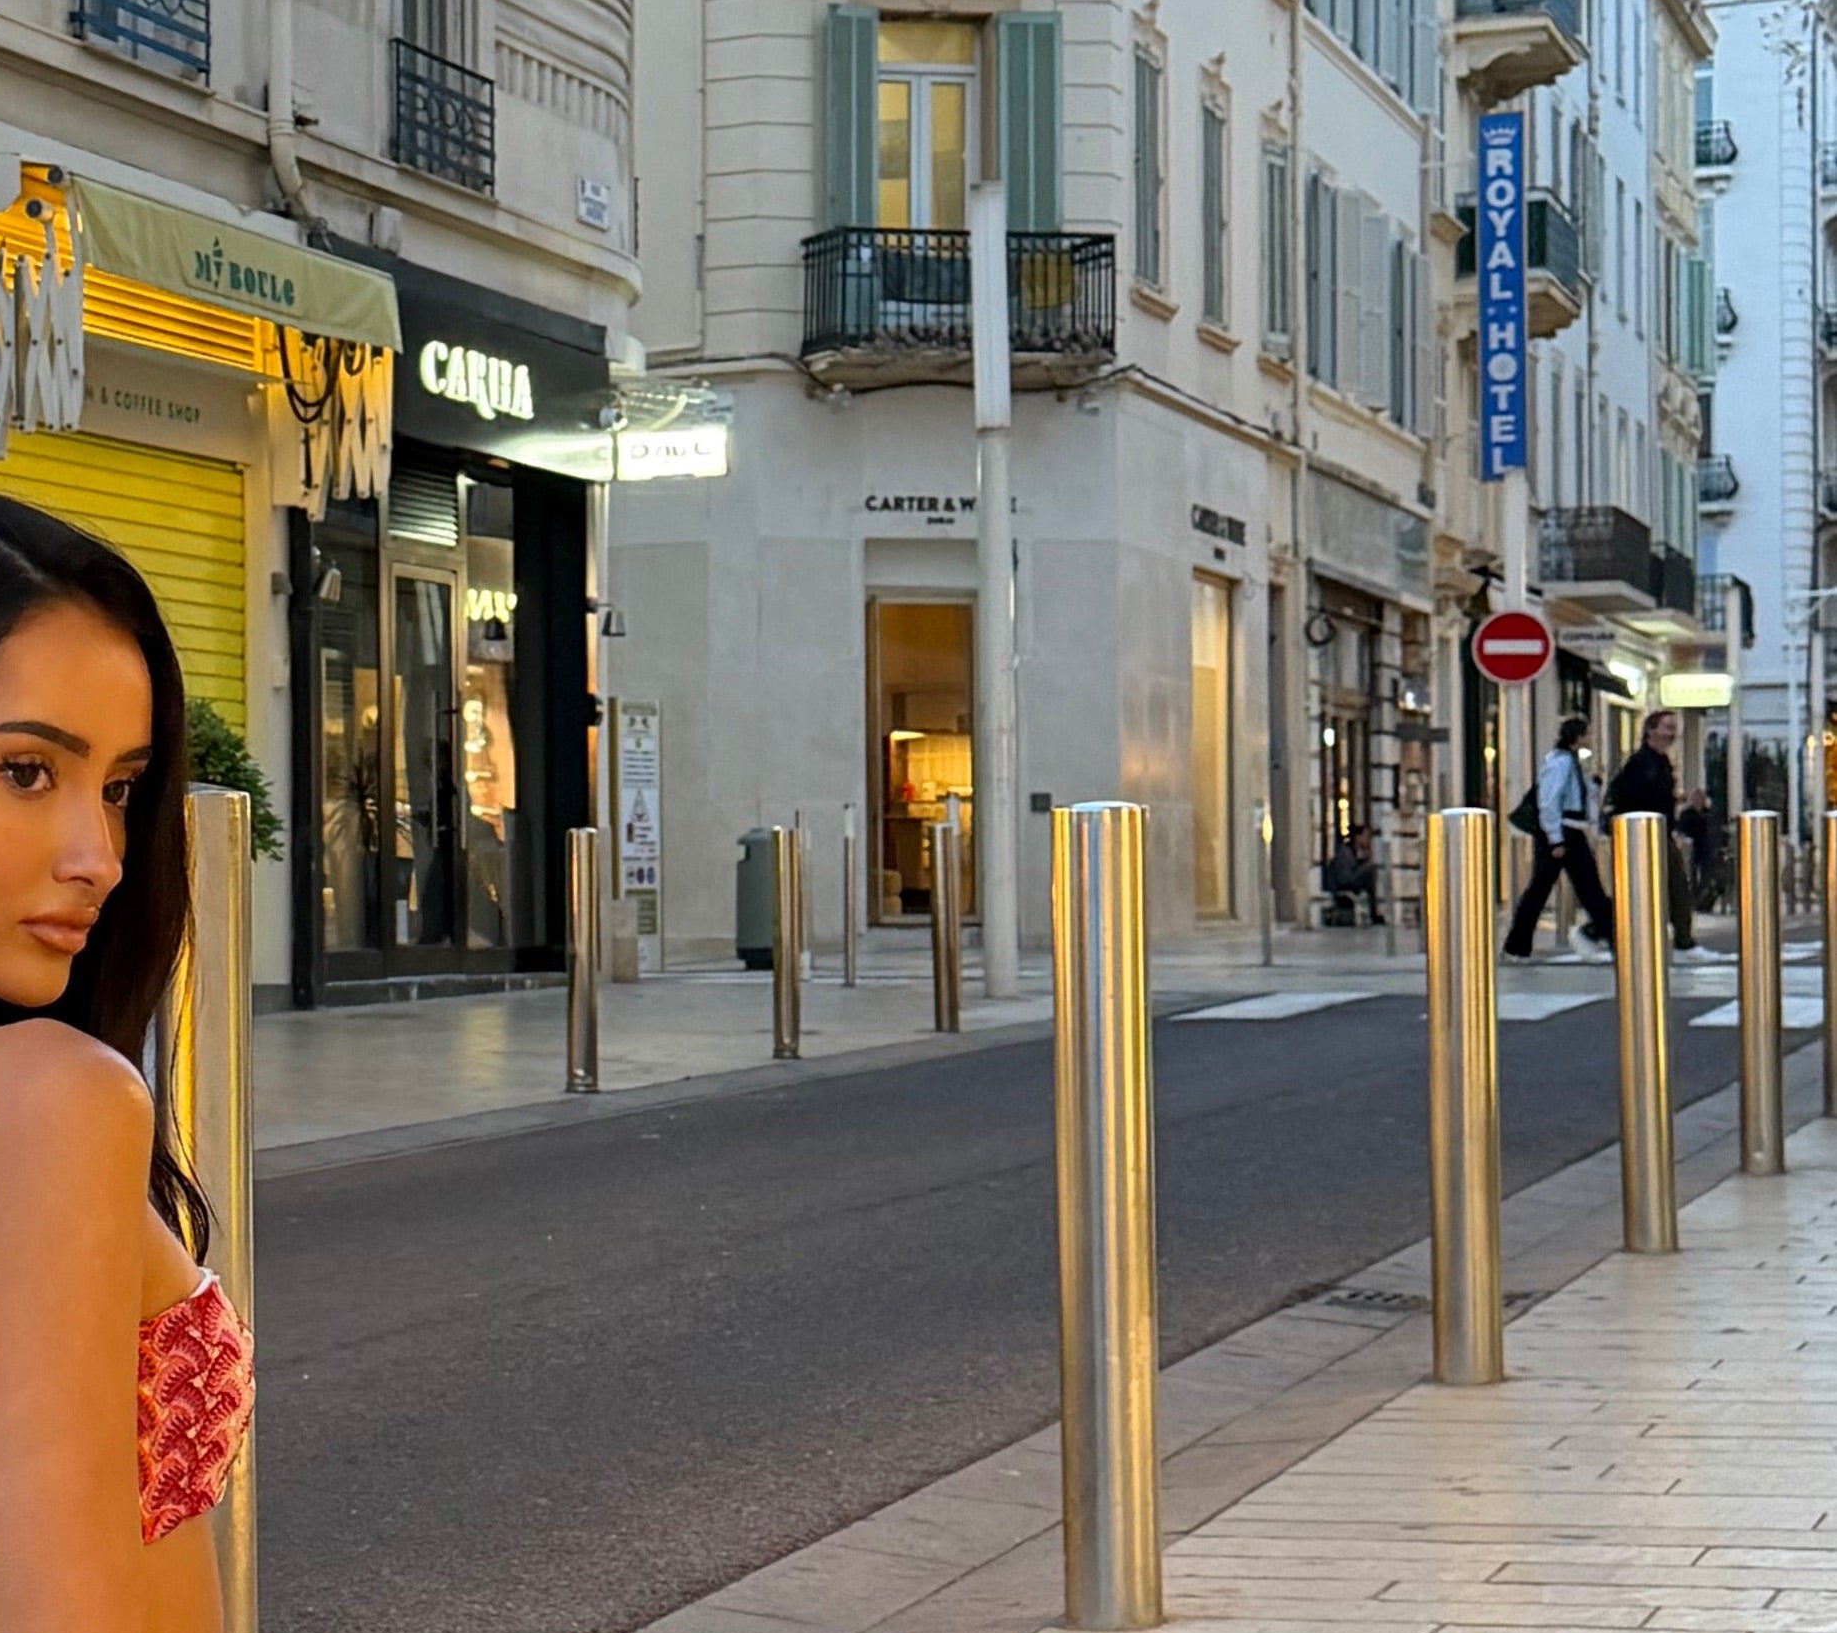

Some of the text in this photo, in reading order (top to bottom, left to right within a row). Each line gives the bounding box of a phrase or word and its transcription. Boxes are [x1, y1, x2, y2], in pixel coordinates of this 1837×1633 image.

[1485, 148, 1518, 475] ROYAL HOTEL
[100, 386, 108, 404] &
[114, 390, 162, 416] COFFEE
[167, 401, 200, 423] SHOP
[865, 495, 939, 512] CARTER
[943, 497, 956, 512] &
